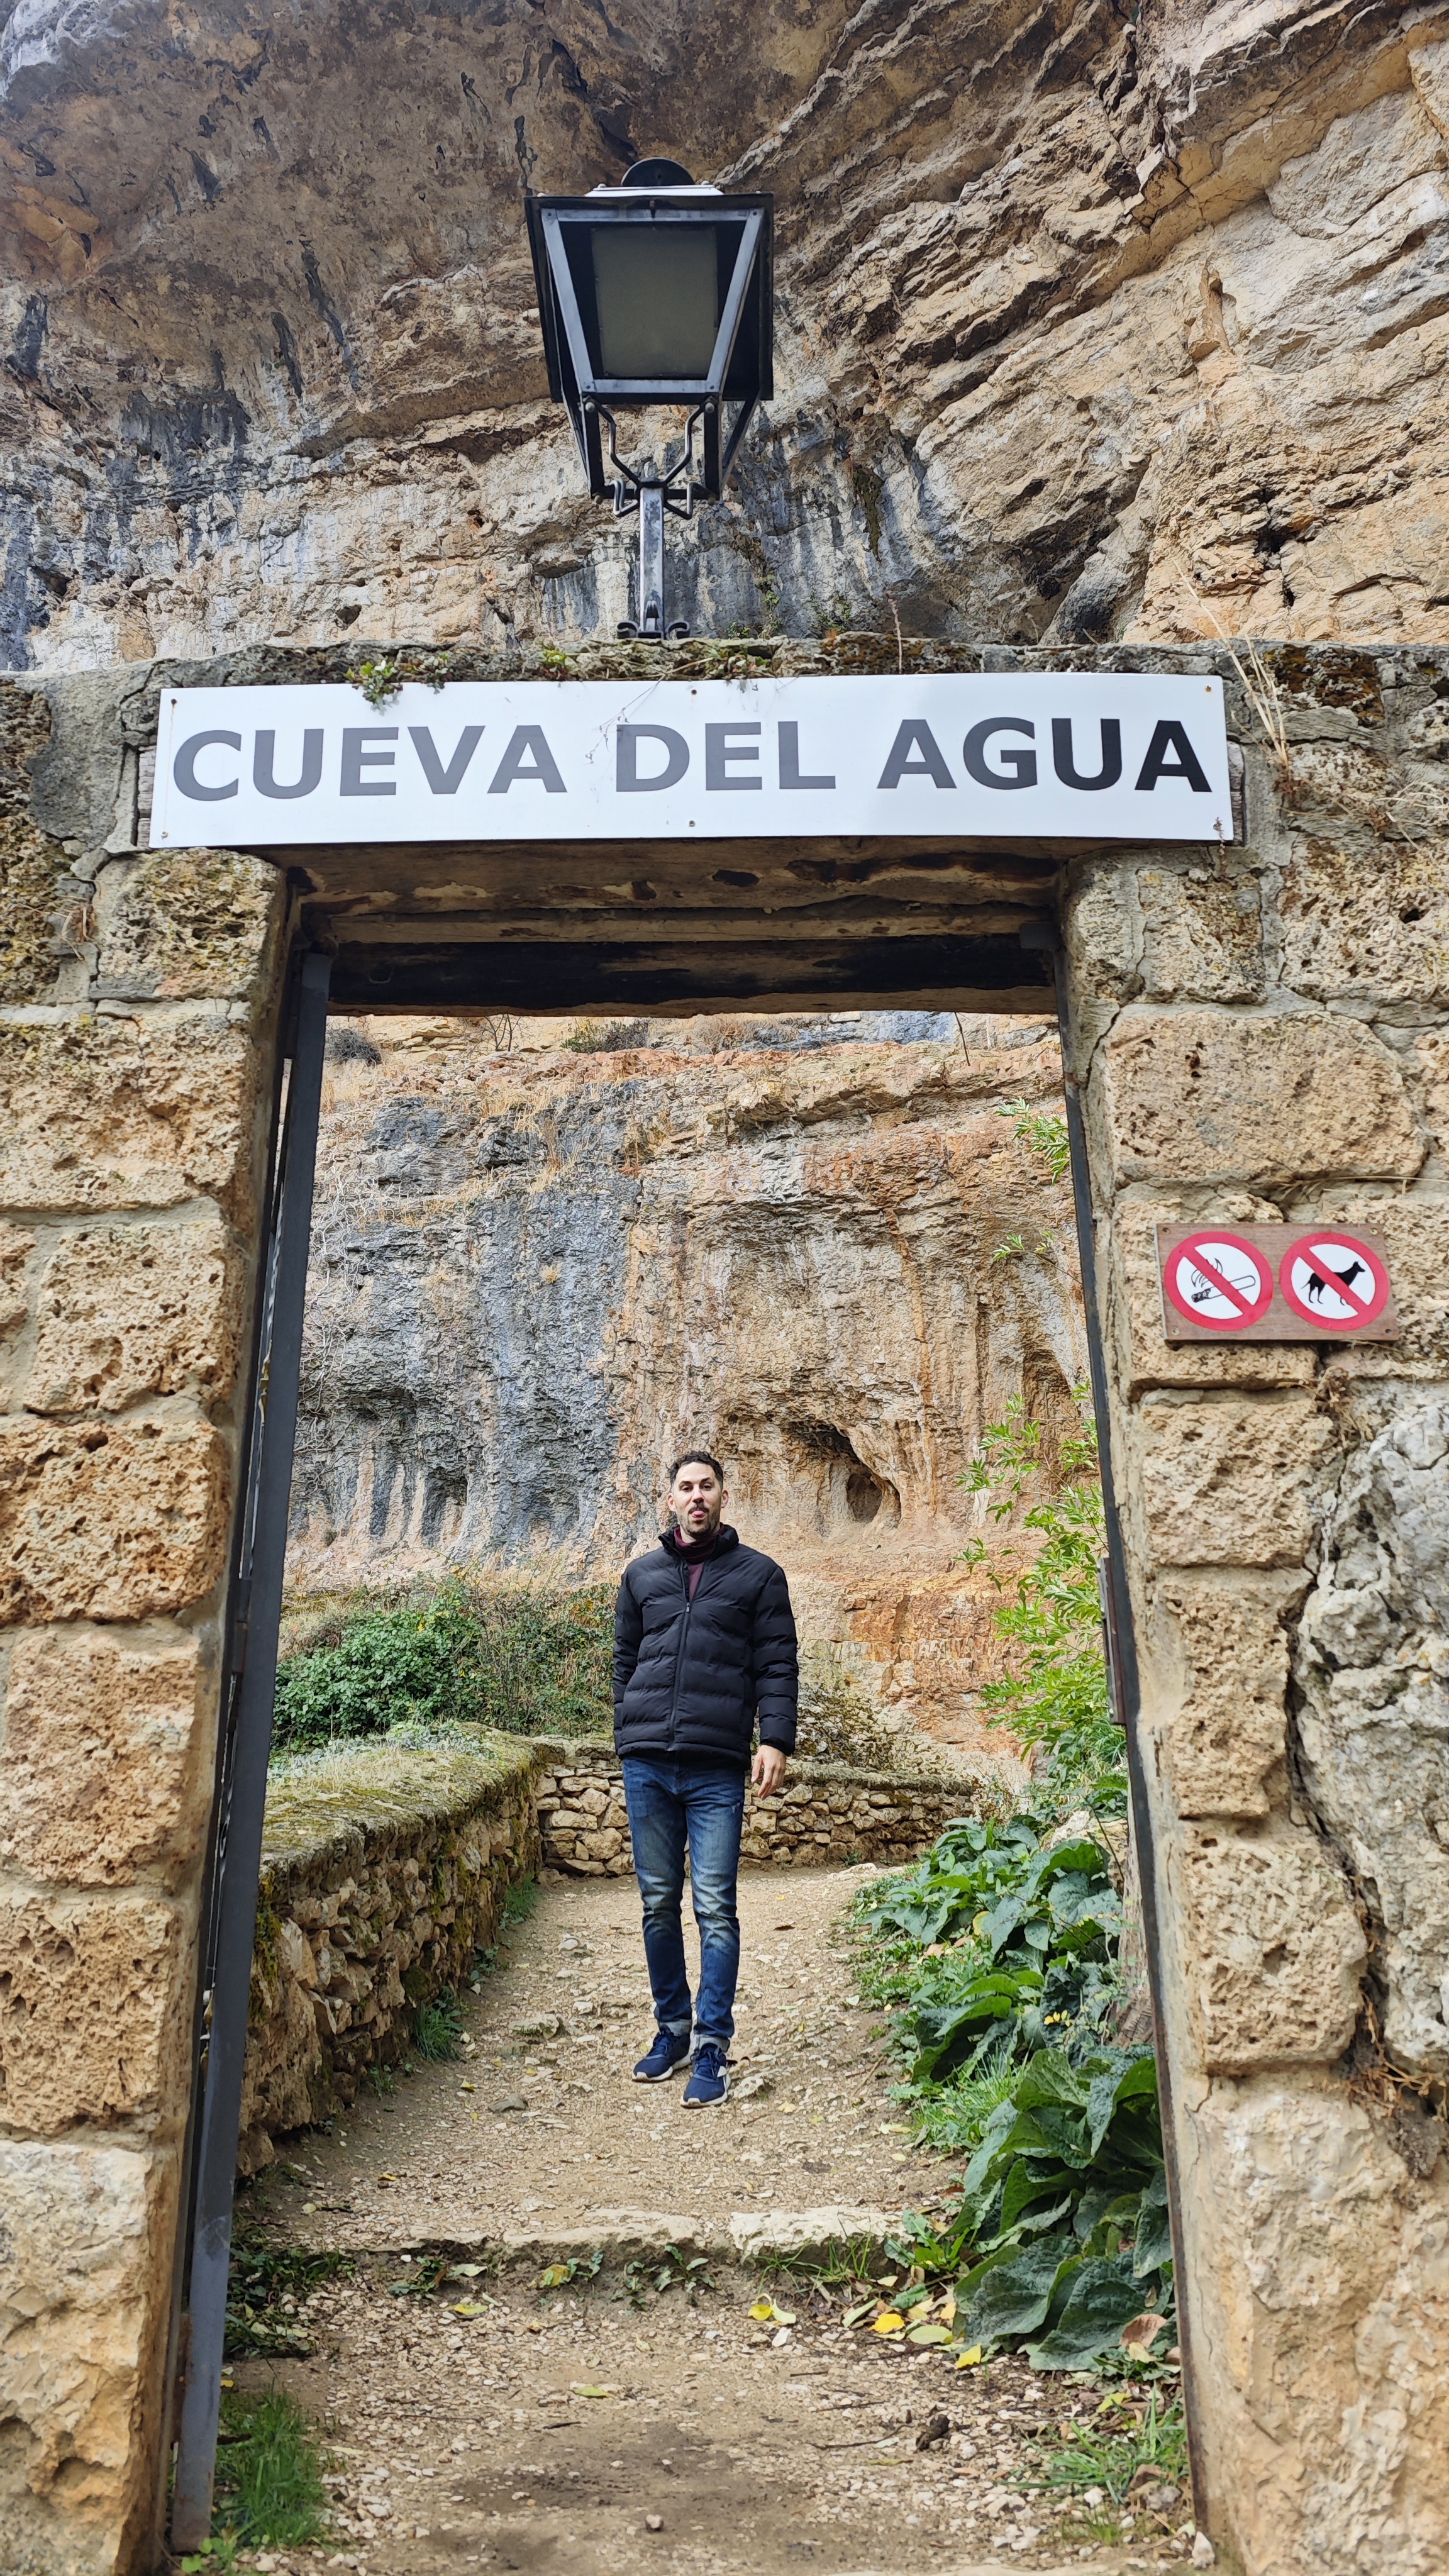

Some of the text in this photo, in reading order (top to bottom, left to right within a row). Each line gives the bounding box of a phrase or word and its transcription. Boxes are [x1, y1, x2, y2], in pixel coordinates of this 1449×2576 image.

[173, 716, 1213, 802] CUEVA DEL AGUA
